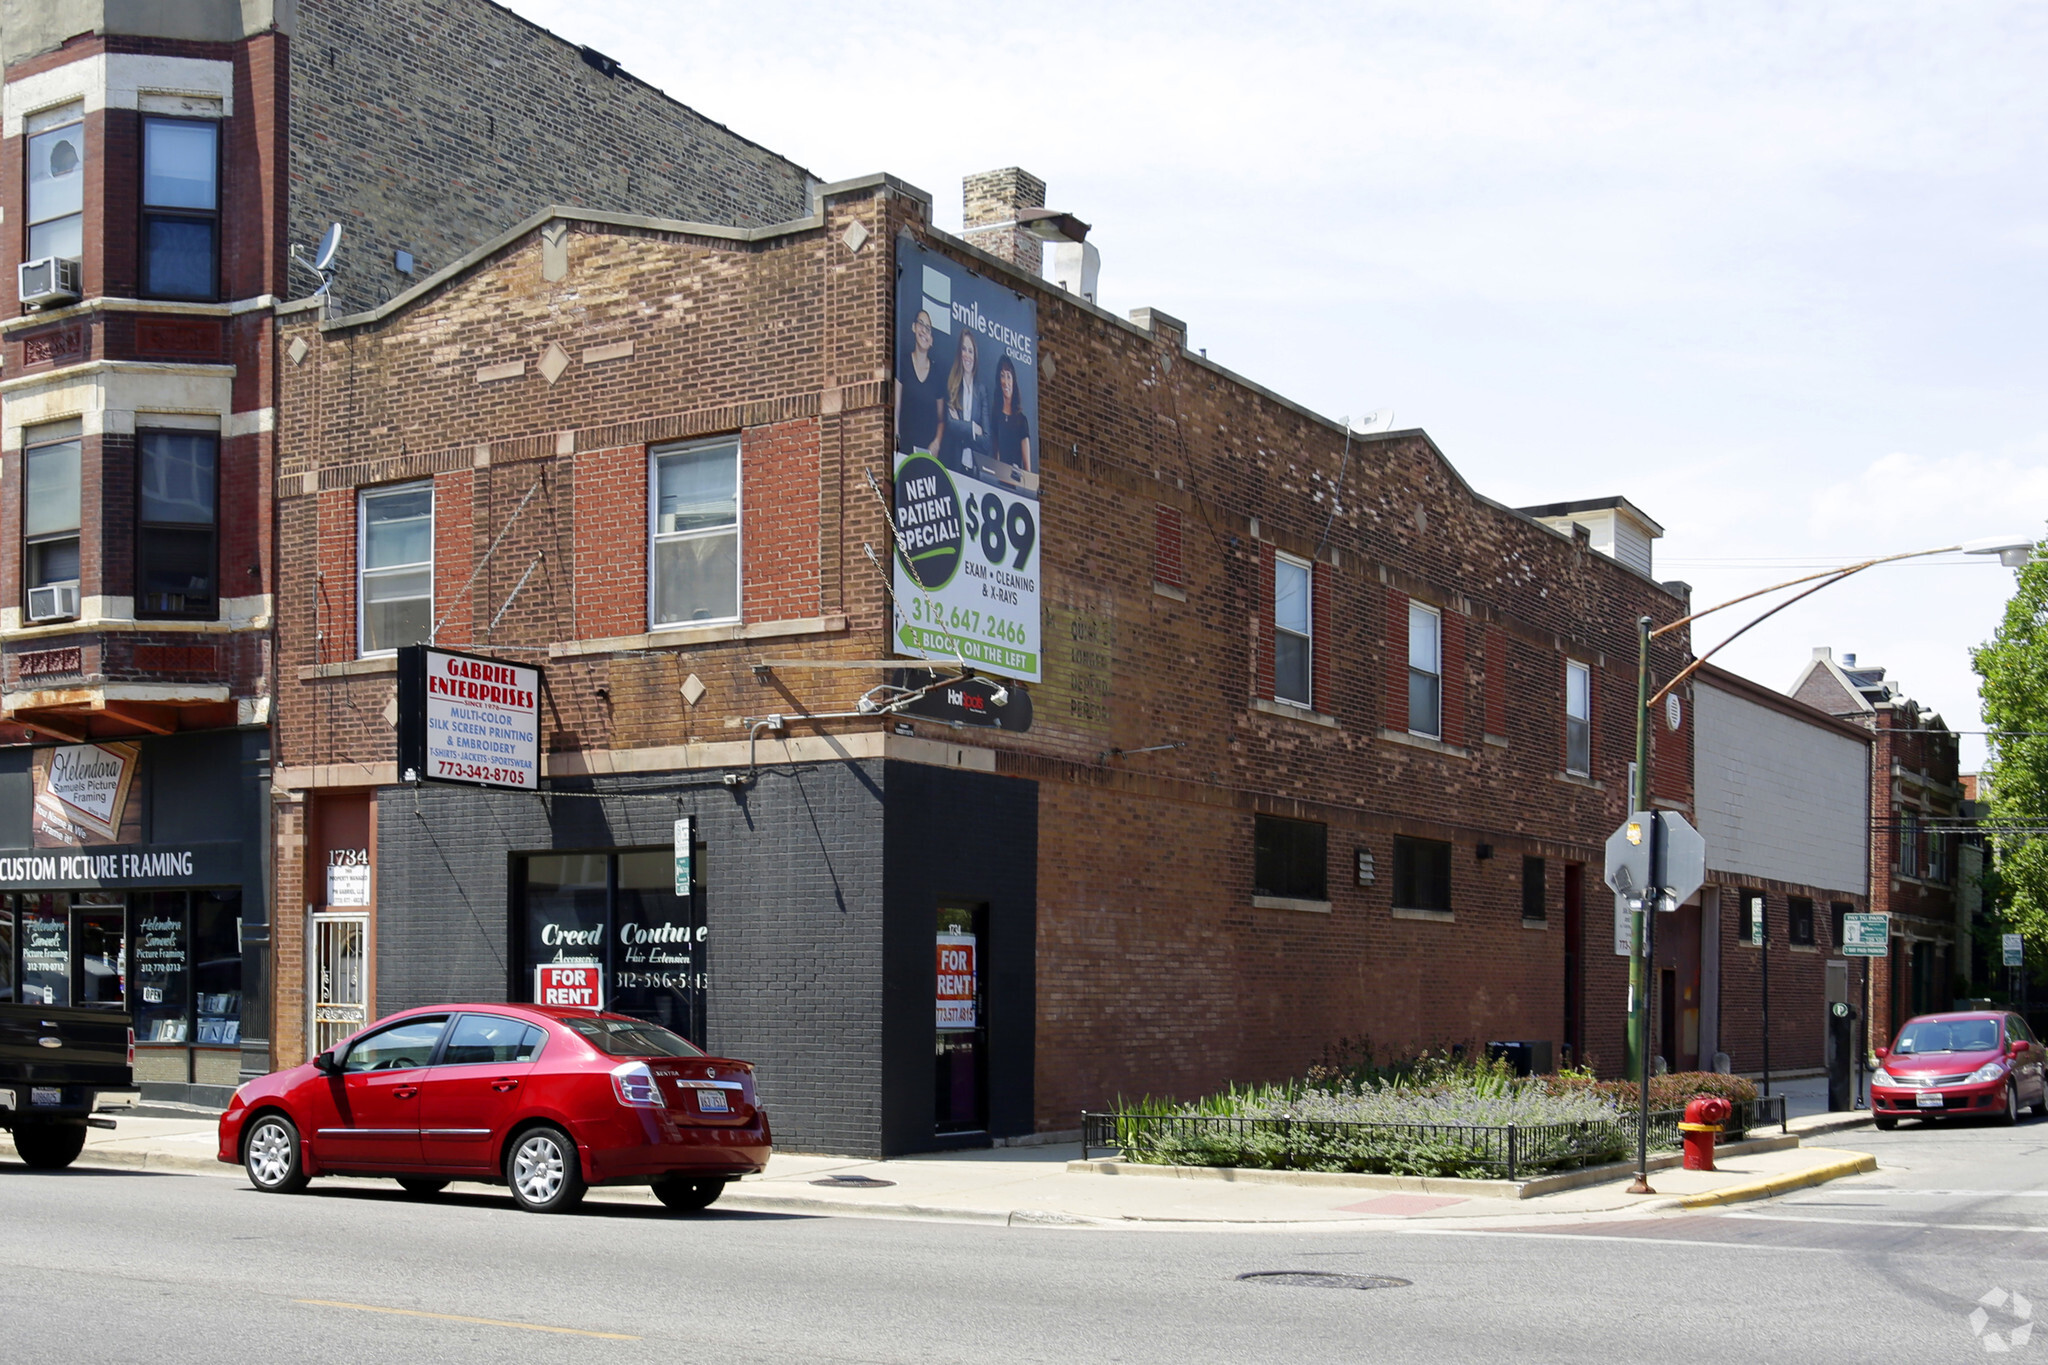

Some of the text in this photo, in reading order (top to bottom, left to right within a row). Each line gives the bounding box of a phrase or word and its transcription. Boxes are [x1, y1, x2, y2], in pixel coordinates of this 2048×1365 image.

[952, 301, 1032, 355] smile SCIENCE
[1006, 347, 1032, 366] CHICAGO
[905, 475, 937, 501] NEW
[897, 496, 952, 528] PATIENT
[898, 518, 961, 551] SPECIAL!
[965, 492, 1035, 571] $89
[965, 561, 1035, 593] EXAM CLEANING
[982, 583, 1018, 606] & X-RAYS
[912, 597, 1026, 645] 312.647.2466
[922, 632, 960, 652] BLOCK
[964, 641, 981, 656] ON
[983, 646, 1002, 664] THE
[1005, 651, 1027, 669] LEFT
[447, 658, 517, 687] GABRIEL
[429, 675, 534, 709] ENTERPRISES
[463, 700, 483, 709] SINCE
[450, 707, 513, 726] MULTI-COLOR
[429, 717, 534, 743] SILK SCREEN PRINTING
[446, 735, 516, 755] & EMBROIDERY
[53, 751, 120, 782] Helendora
[430, 747, 533, 769] T-SHIRTS JACKETS SPORTSWEAR
[438, 760, 525, 785] 773-342-8705
[54, 780, 117, 793] Samuels Picture
[73, 792, 106, 803] Framing
[35, 803, 48, 817] You
[47, 811, 68, 830] Name
[74, 826, 87, 839] We
[41, 820, 64, 841] Frame
[0, 851, 193, 881] CUSTOM PICTURE FRAMING
[328, 848, 369, 866] 1734
[140, 916, 182, 934] Helendora
[541, 923, 604, 946] Creed
[31, 932, 61, 947] Samuels
[145, 932, 177, 947] Samuels
[22, 948, 69, 962] Picture Framing
[136, 948, 185, 962] Picture Framing
[625, 947, 646, 964] Hair
[941, 950, 967, 971] FOR
[551, 969, 588, 987] FOR
[937, 974, 972, 995] RENT
[145, 988, 161, 1000] OPEN
[545, 988, 593, 1005] RENT
